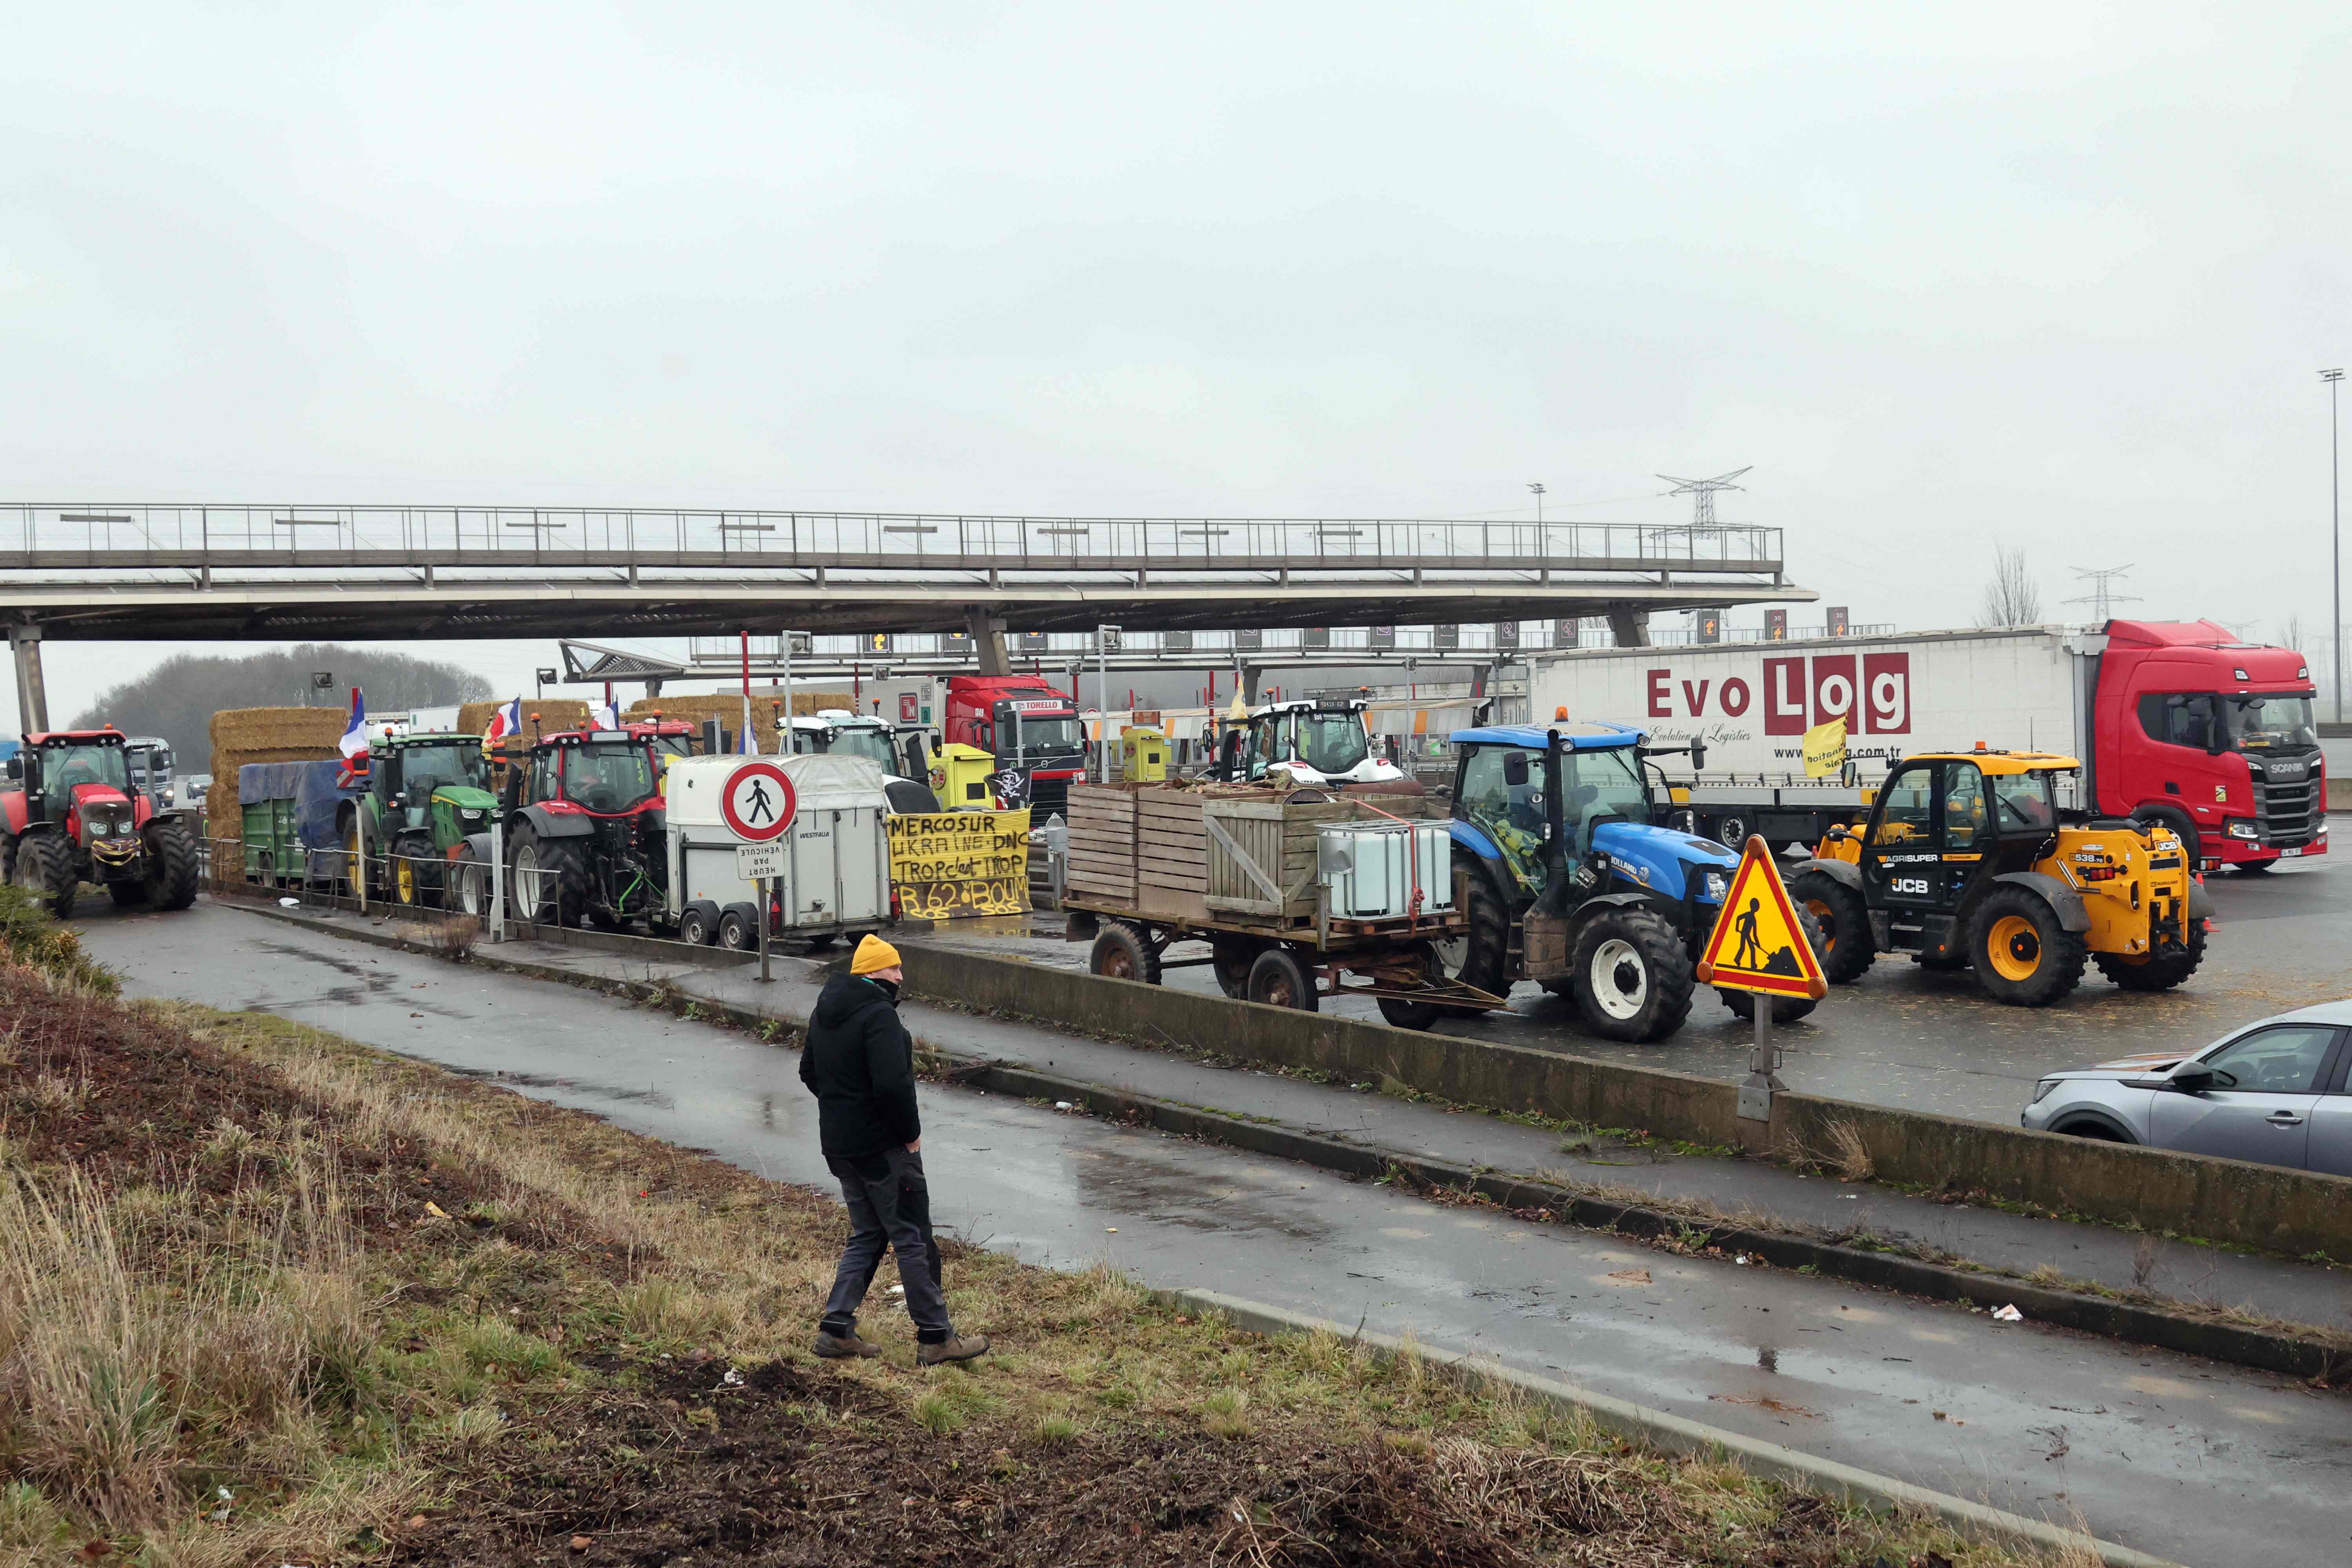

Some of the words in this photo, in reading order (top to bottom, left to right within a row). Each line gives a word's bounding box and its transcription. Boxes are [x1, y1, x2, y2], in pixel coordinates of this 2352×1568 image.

[1650, 725, 1691, 742] Evolution
[1707, 723, 1752, 747] Logistics
[2270, 763, 2304, 773] SCANIA
[891, 817, 996, 837] MERCOSUR
[993, 830, 1029, 851] DNC
[2158, 842, 2178, 851] JCB
[740, 846, 780, 856] VÉHICULE
[1886, 854, 1938, 862] AGRISUPER
[749, 867, 775, 876] HEURT
[895, 861, 945, 883] TROP
[983, 855, 1022, 877] TROP
[1892, 878, 1928, 894] JCB
[927, 883, 960, 909] 62
[981, 900, 1022, 916] SOS
